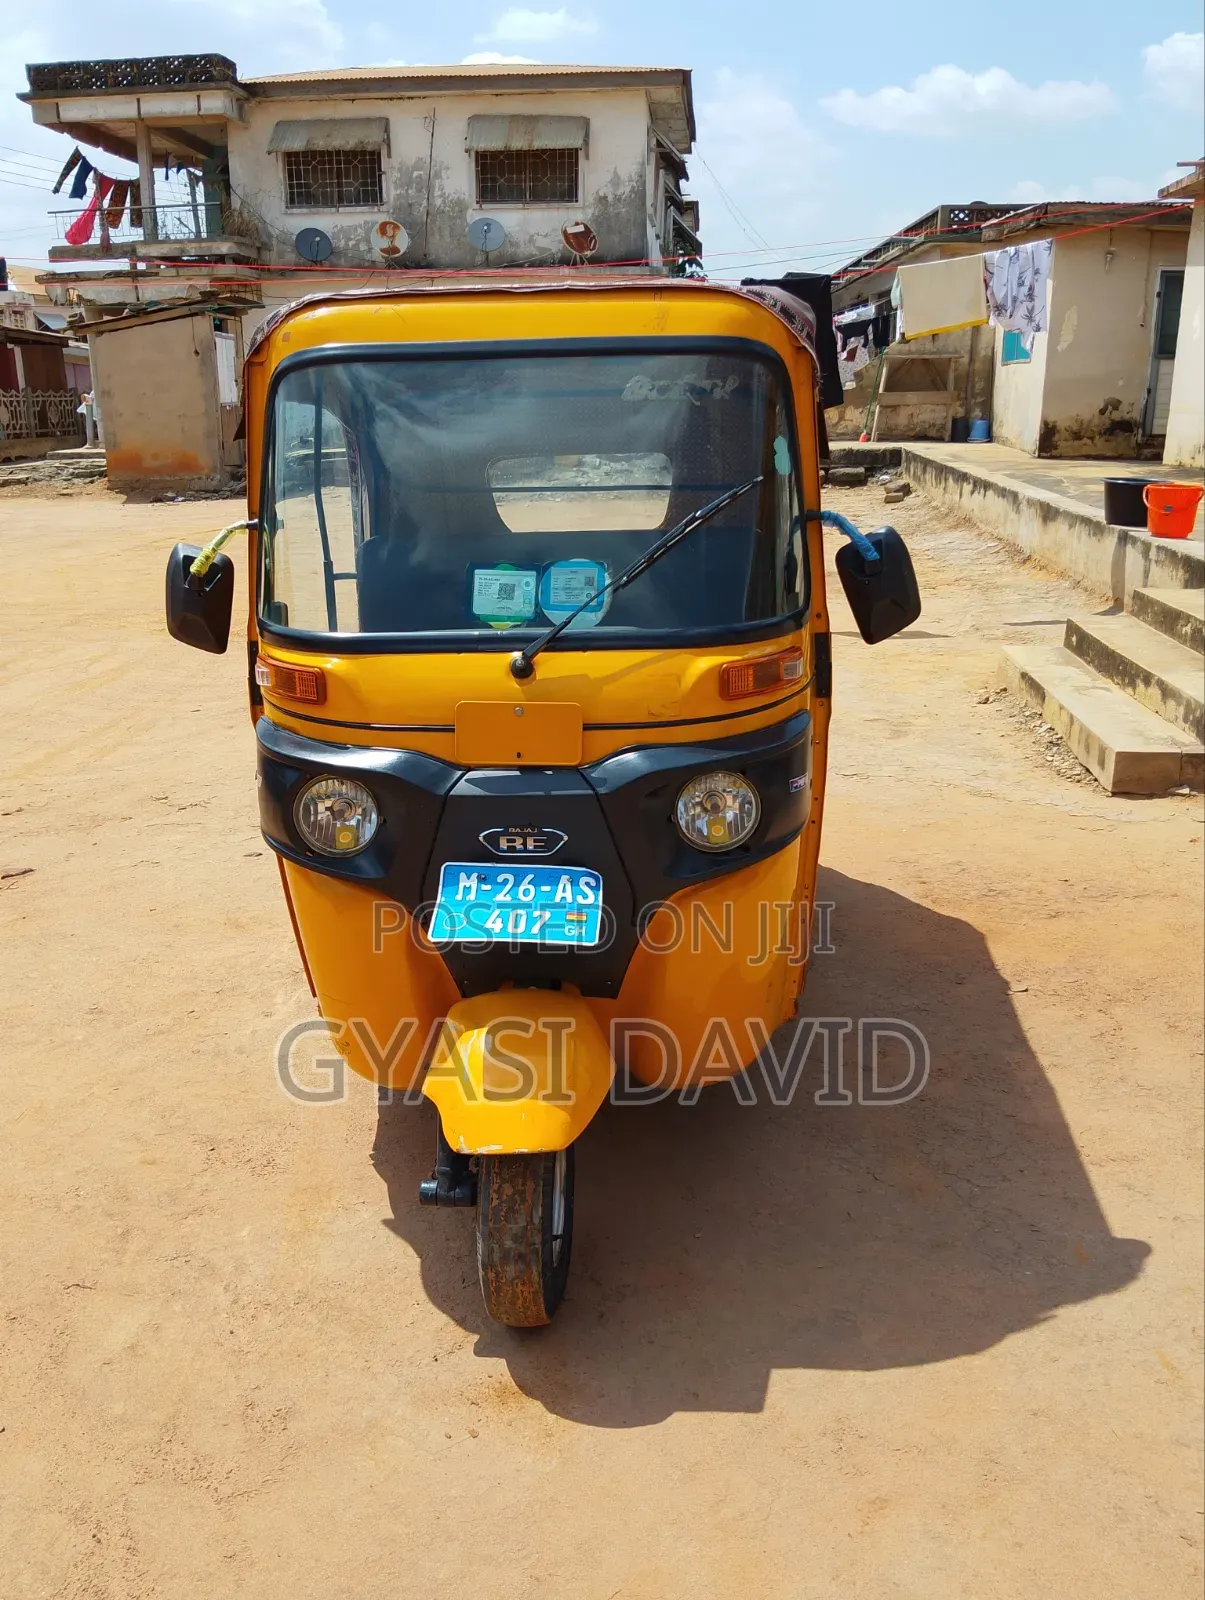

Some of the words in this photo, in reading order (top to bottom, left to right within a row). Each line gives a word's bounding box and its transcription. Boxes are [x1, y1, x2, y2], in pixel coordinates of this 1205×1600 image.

[499, 836, 548, 851] RE
[454, 872, 597, 905] M-26-AS
[484, 908, 552, 935] 407
[564, 924, 586, 937] GH
